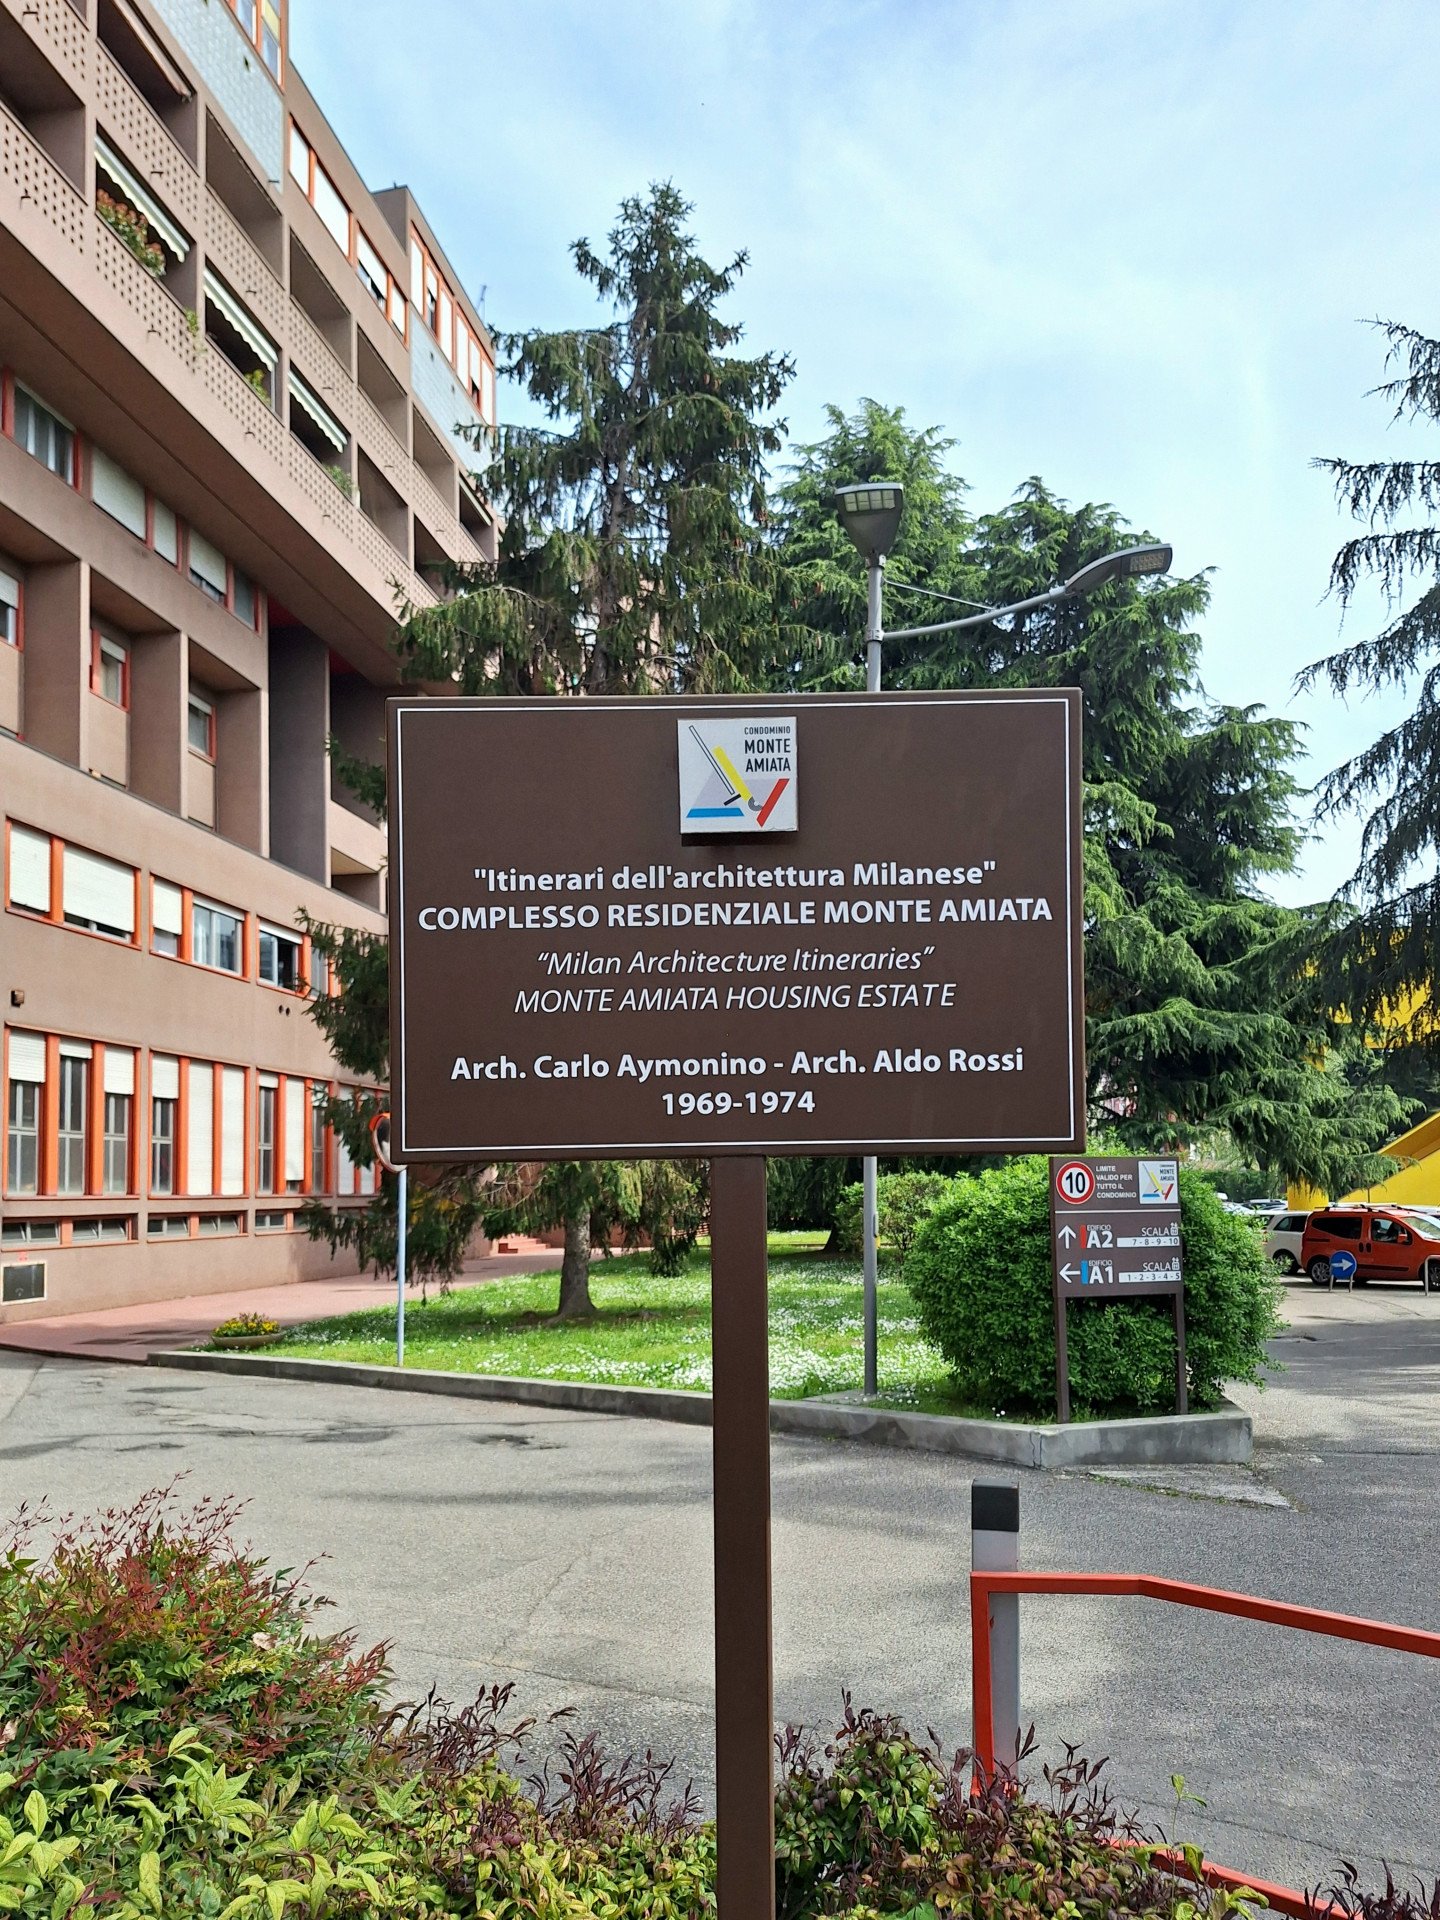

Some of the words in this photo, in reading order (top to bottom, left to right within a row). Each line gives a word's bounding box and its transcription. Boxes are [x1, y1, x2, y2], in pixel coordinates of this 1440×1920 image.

[744, 726, 791, 735] CONDOMINIO
[744, 738, 791, 754] MONTE
[745, 757, 791, 772] AMIATA
[474, 866, 604, 892] "Itinerari
[612, 864, 845, 890] dell'architettura
[853, 860, 996, 886] Milanese"
[418, 904, 600, 931] COMPLESSO
[607, 901, 816, 927] RESIDENZIALE
[823, 899, 932, 924] MONTE
[938, 897, 1053, 922] AMIATA
[627, 949, 787, 974] Architecture
[514, 988, 613, 1013] MONTE
[619, 986, 719, 1011] AMIATA
[725, 984, 851, 1010] HOUSING
[857, 983, 957, 1008] ESTATE
[450, 1055, 527, 1080] Arch.
[533, 1053, 610, 1079] Carlo
[616, 1051, 767, 1083] Aymonino
[790, 1049, 866, 1074] Arch.
[873, 1048, 941, 1073] Aldo
[949, 1047, 1023, 1072] Rossi
[662, 1090, 816, 1116] 1969-1974
[1065, 1171, 1086, 1194] 10
[1086, 1230, 1114, 1249] A2
[1141, 1227, 1170, 1236] SCALA
[1089, 1266, 1114, 1284] A1
[1142, 1261, 1172, 1272] SCALA
